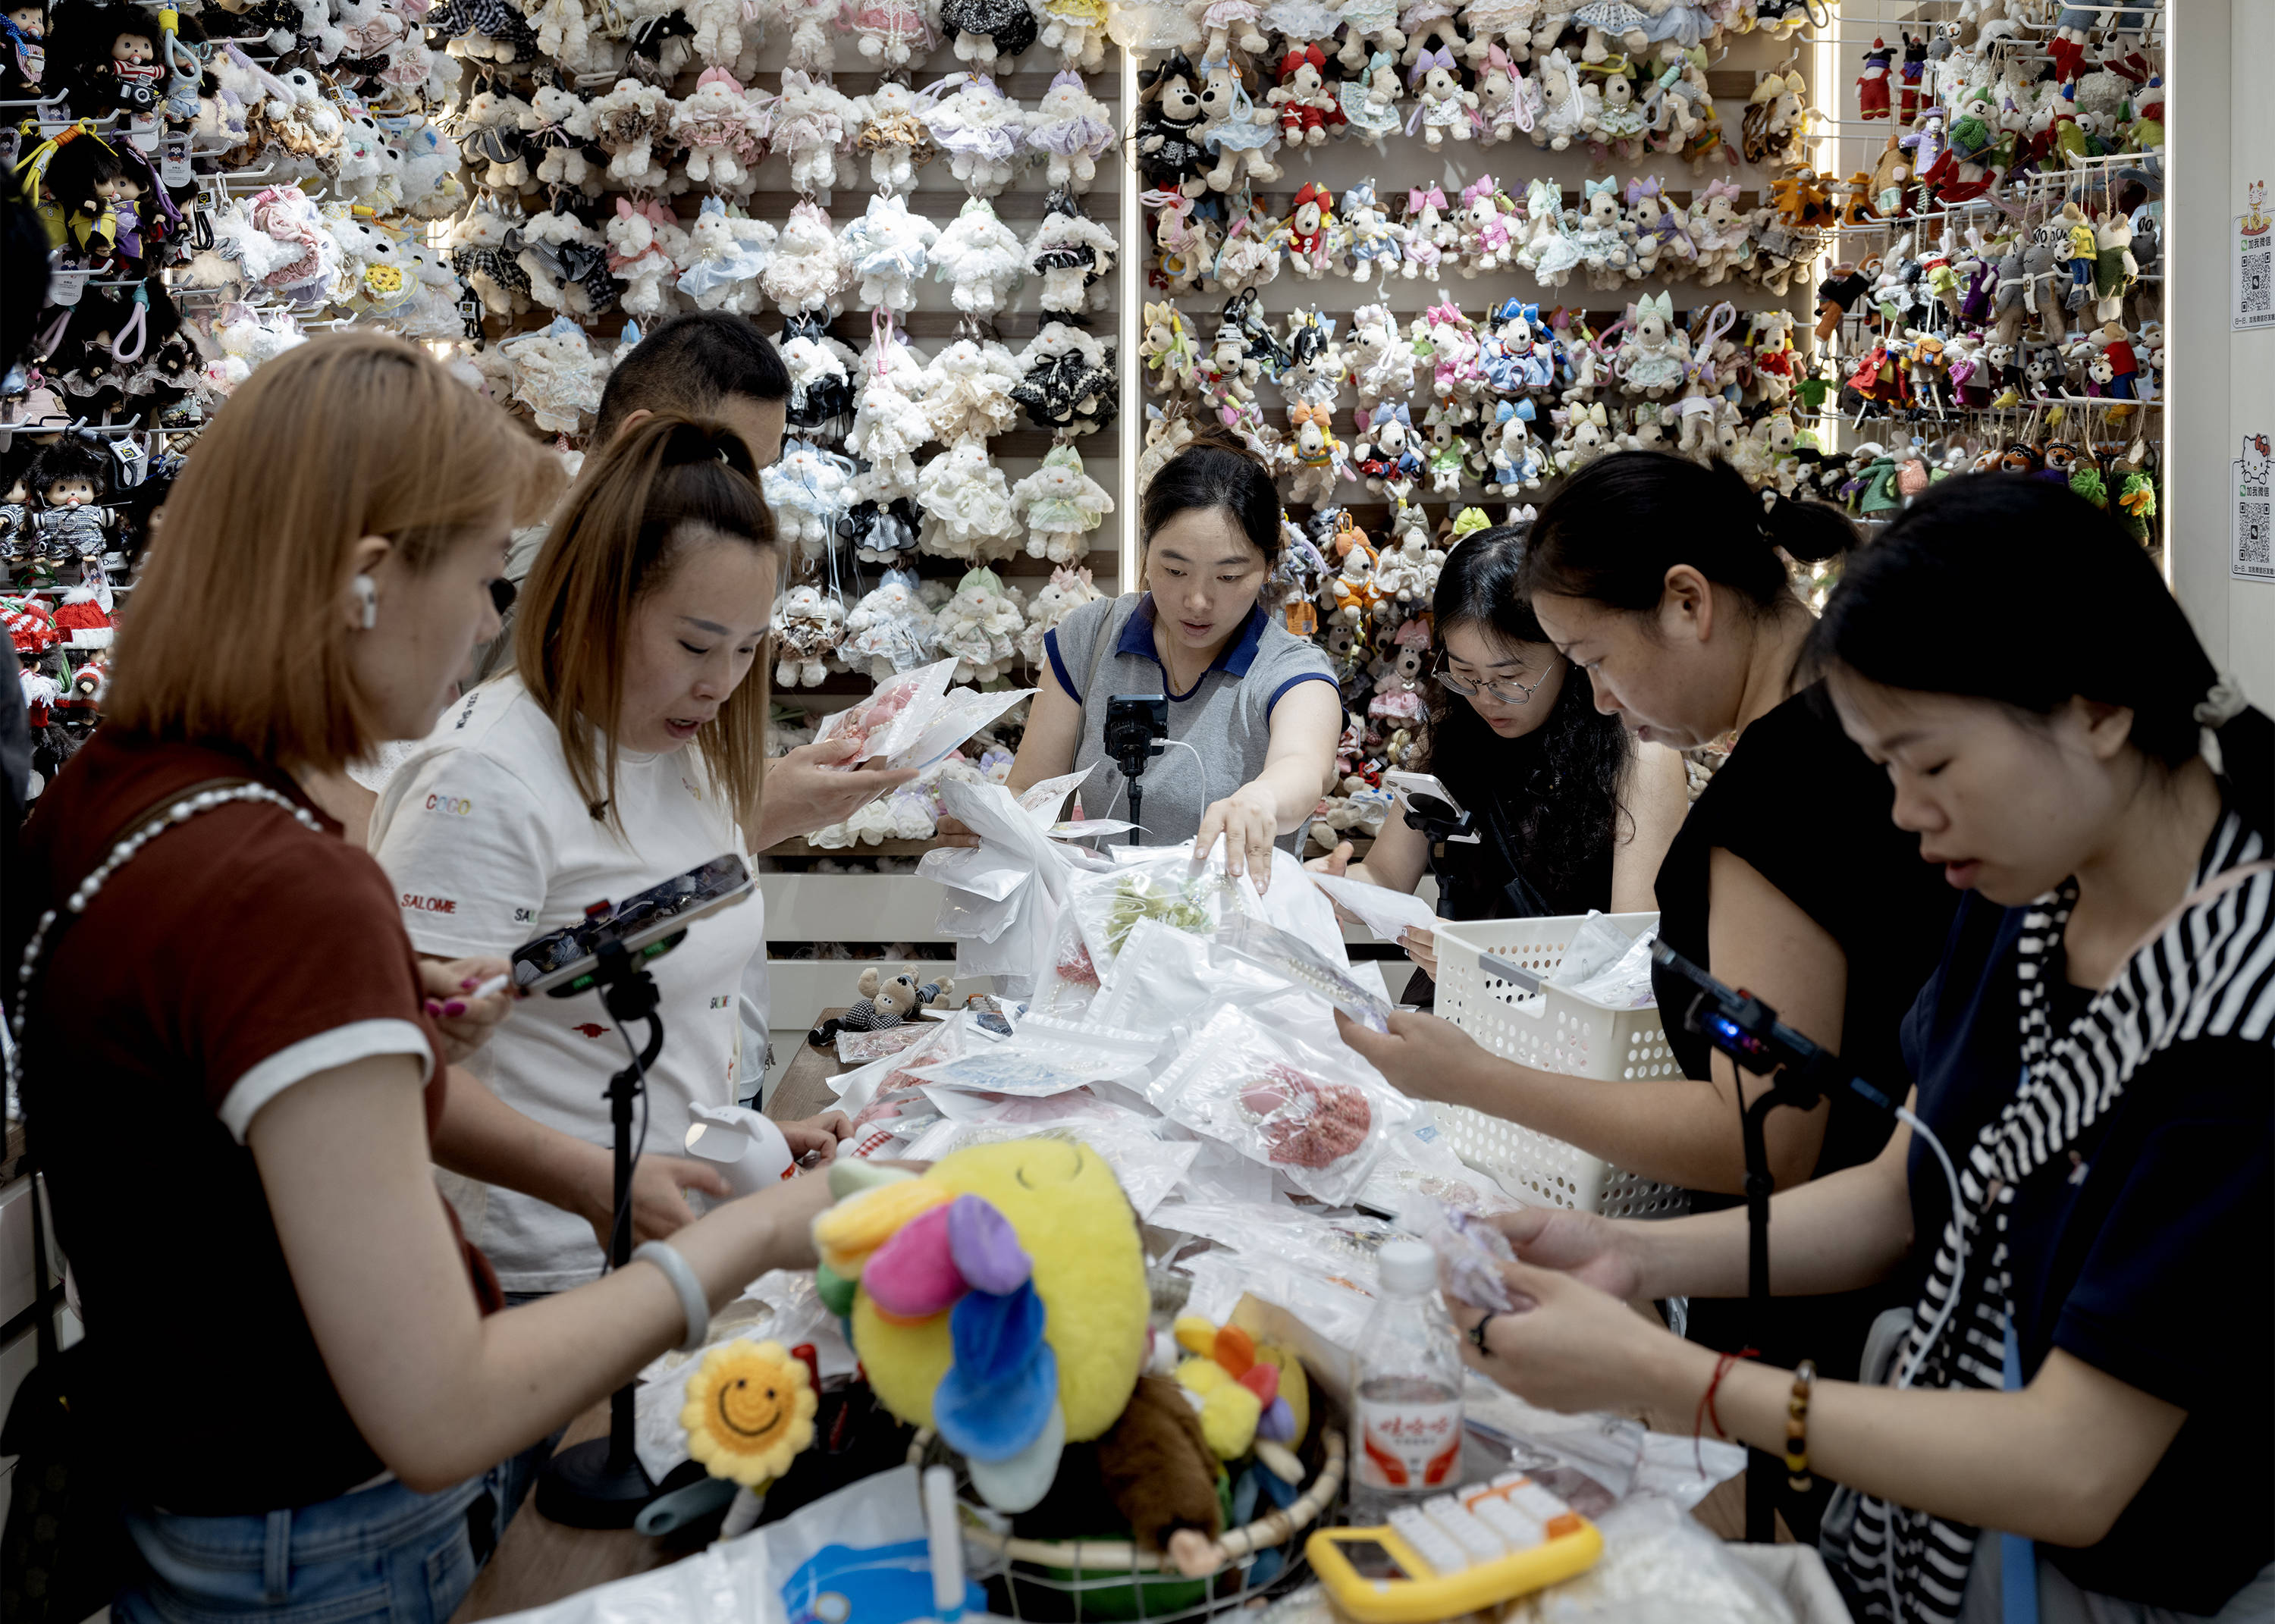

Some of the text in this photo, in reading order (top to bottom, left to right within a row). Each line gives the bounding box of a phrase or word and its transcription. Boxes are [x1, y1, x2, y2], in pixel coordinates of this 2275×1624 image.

[47, 208, 53, 218] 8
[425, 793, 471, 816] COCO
[401, 893, 457, 914] SALOME
